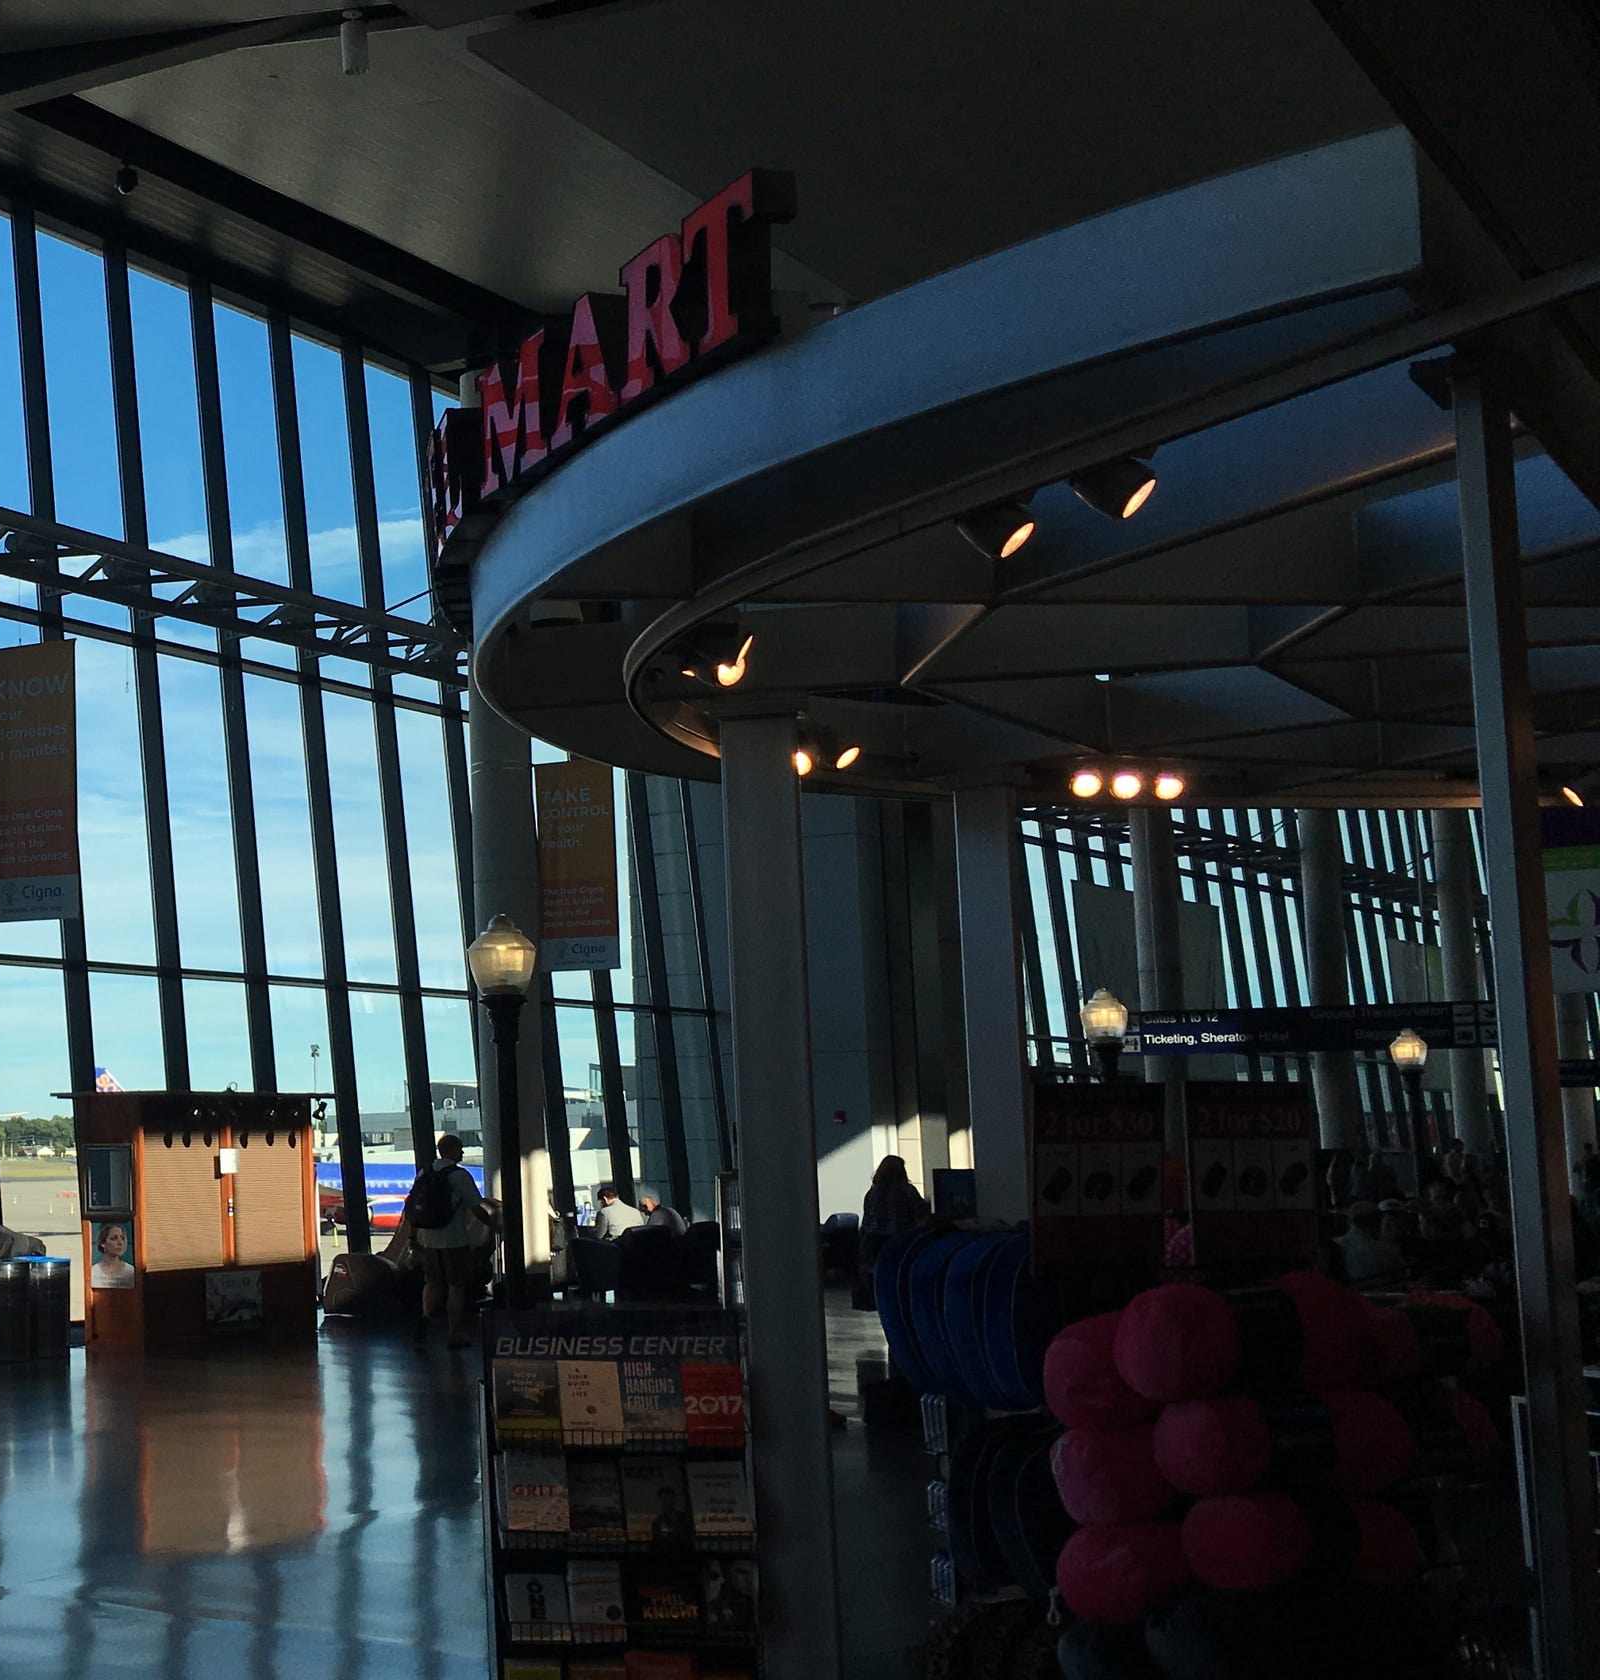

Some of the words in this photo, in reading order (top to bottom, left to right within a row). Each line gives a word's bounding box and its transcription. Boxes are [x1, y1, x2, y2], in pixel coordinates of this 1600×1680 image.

[541, 787, 593, 805] TAKE
[541, 803, 609, 820] CONTROL
[22, 884, 62, 902] Cigna
[571, 943, 606, 957] Cigna
[1144, 1033, 1198, 1046] Ticketing,
[1200, 1031, 1253, 1044] Sheraton
[495, 1336, 624, 1356] BUSINESS
[629, 1336, 725, 1356] CENTER
[623, 1361, 656, 1377] HIGH-
[625, 1378, 675, 1394] HANGING
[684, 1395, 743, 1415] 2017
[511, 1483, 555, 1498] GRIT
[650, 1590, 688, 1606] PHIL
[641, 1602, 701, 1620] KNIGHT
